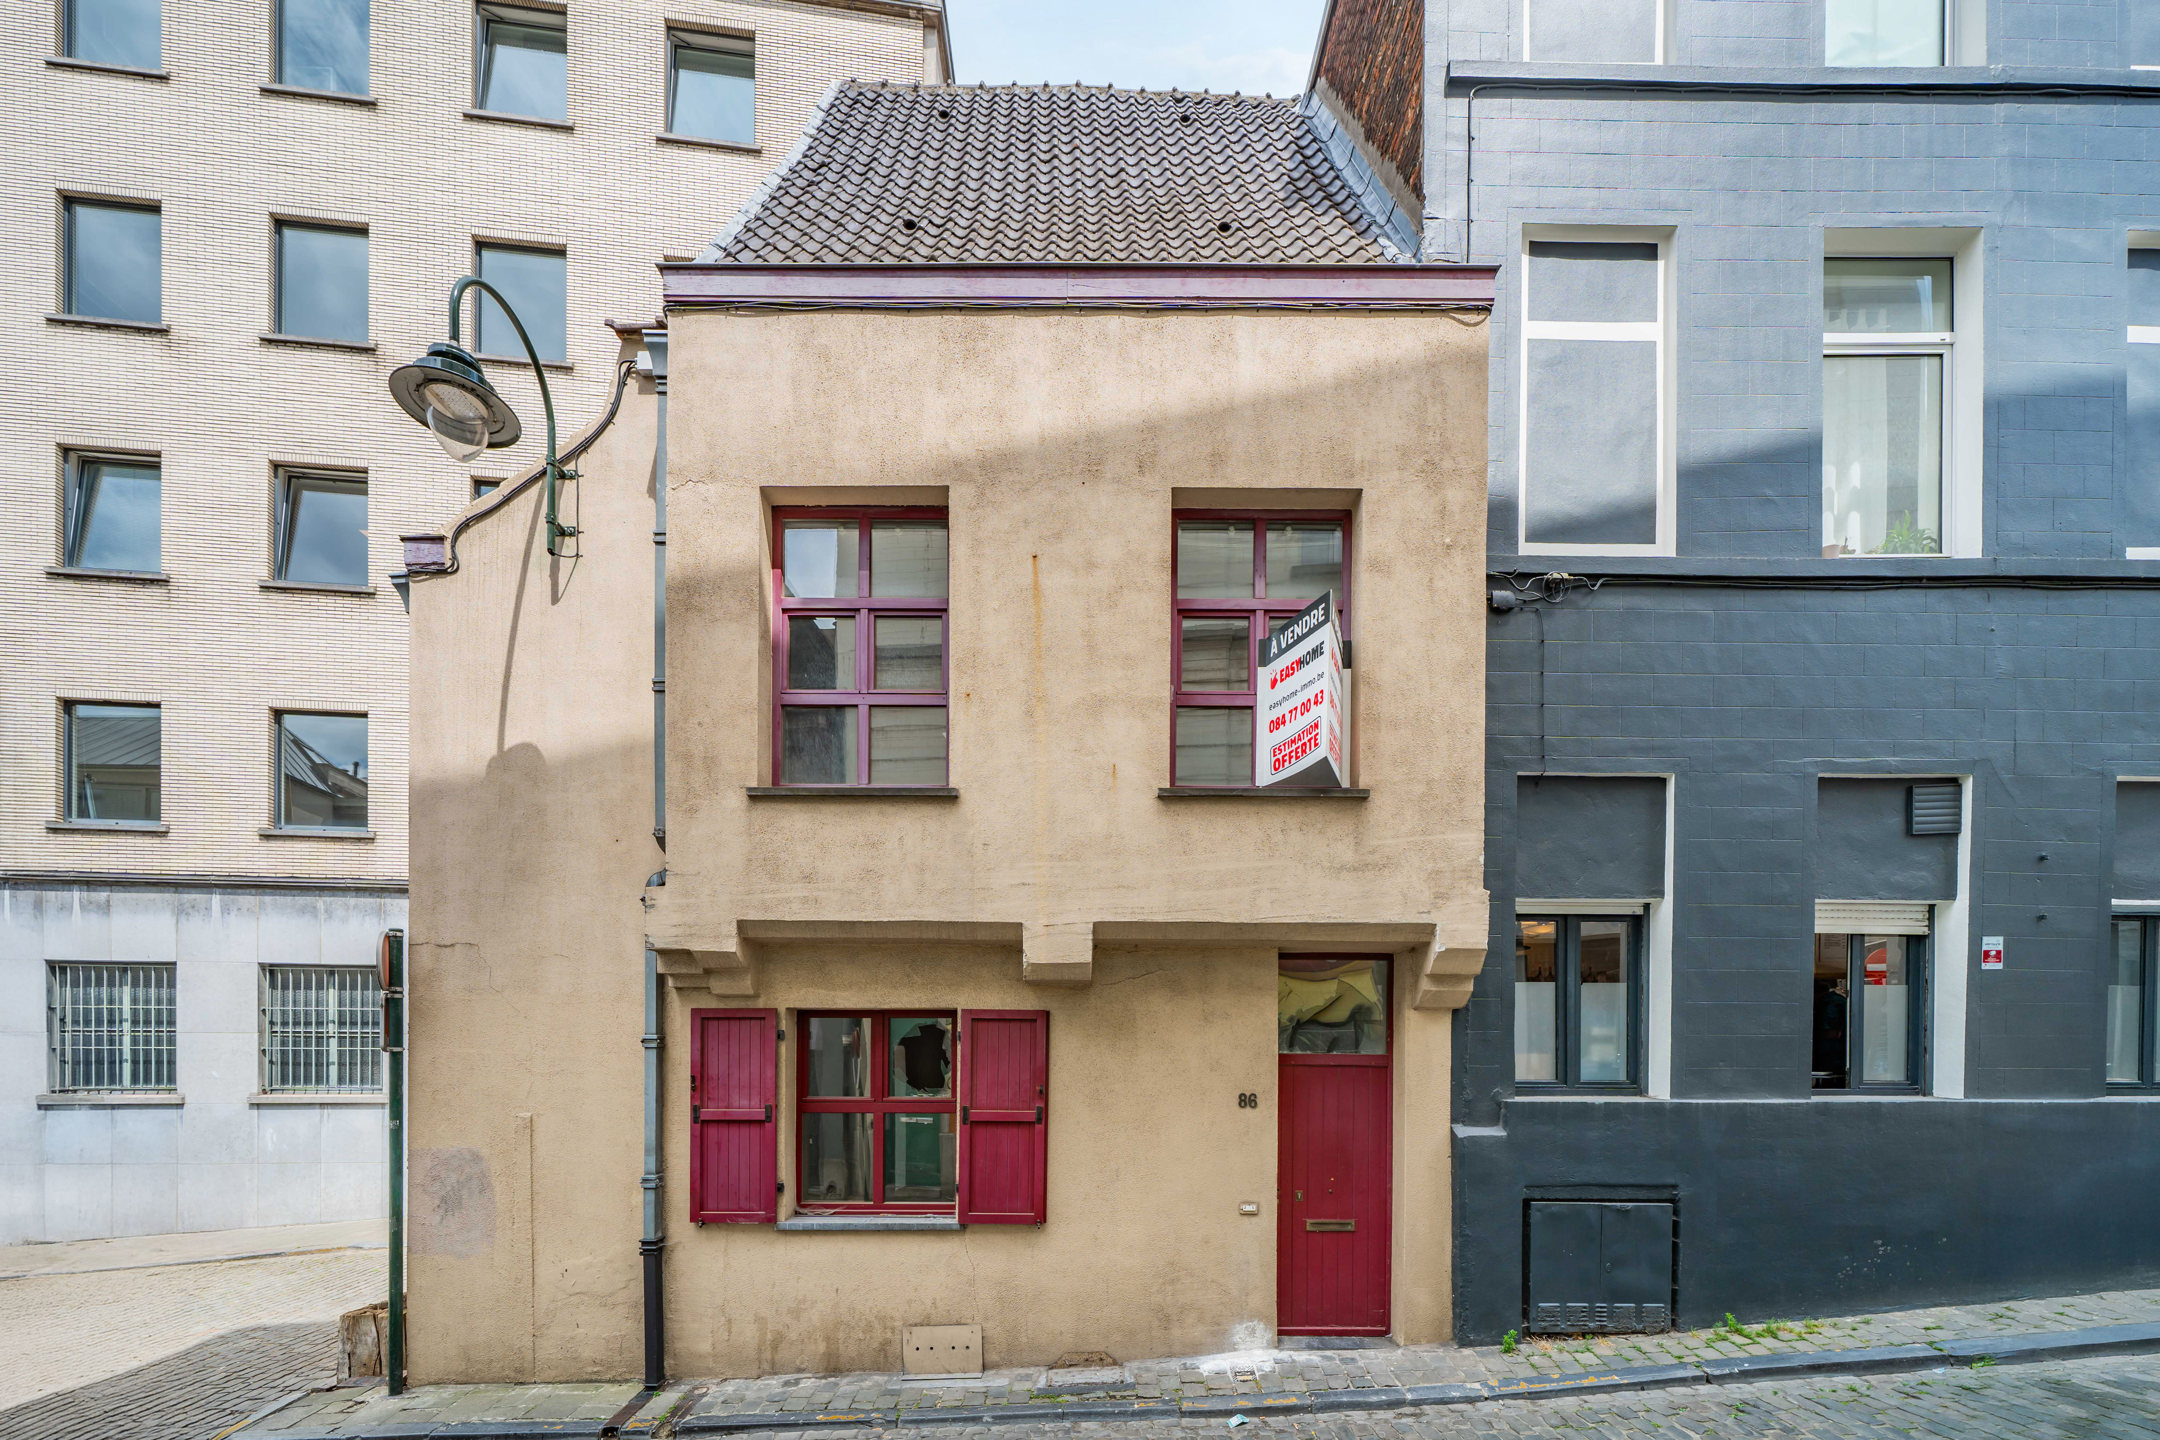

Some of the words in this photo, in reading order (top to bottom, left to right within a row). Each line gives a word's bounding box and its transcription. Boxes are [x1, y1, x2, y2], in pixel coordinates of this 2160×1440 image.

[1270, 637, 1278, 657] À
[1280, 603, 1326, 649] VENDRE
[1269, 671, 1325, 711] easyhome-immo.be
[1269, 713, 1287, 734] 084
[1288, 706, 1298, 724] 77
[1300, 698, 1312, 717] 00
[1313, 689, 1324, 708] 43
[1272, 720, 1319, 758] ESTIMATION
[1273, 731, 1320, 772] OFFERTE
[1238, 1092, 1258, 1109] 86
